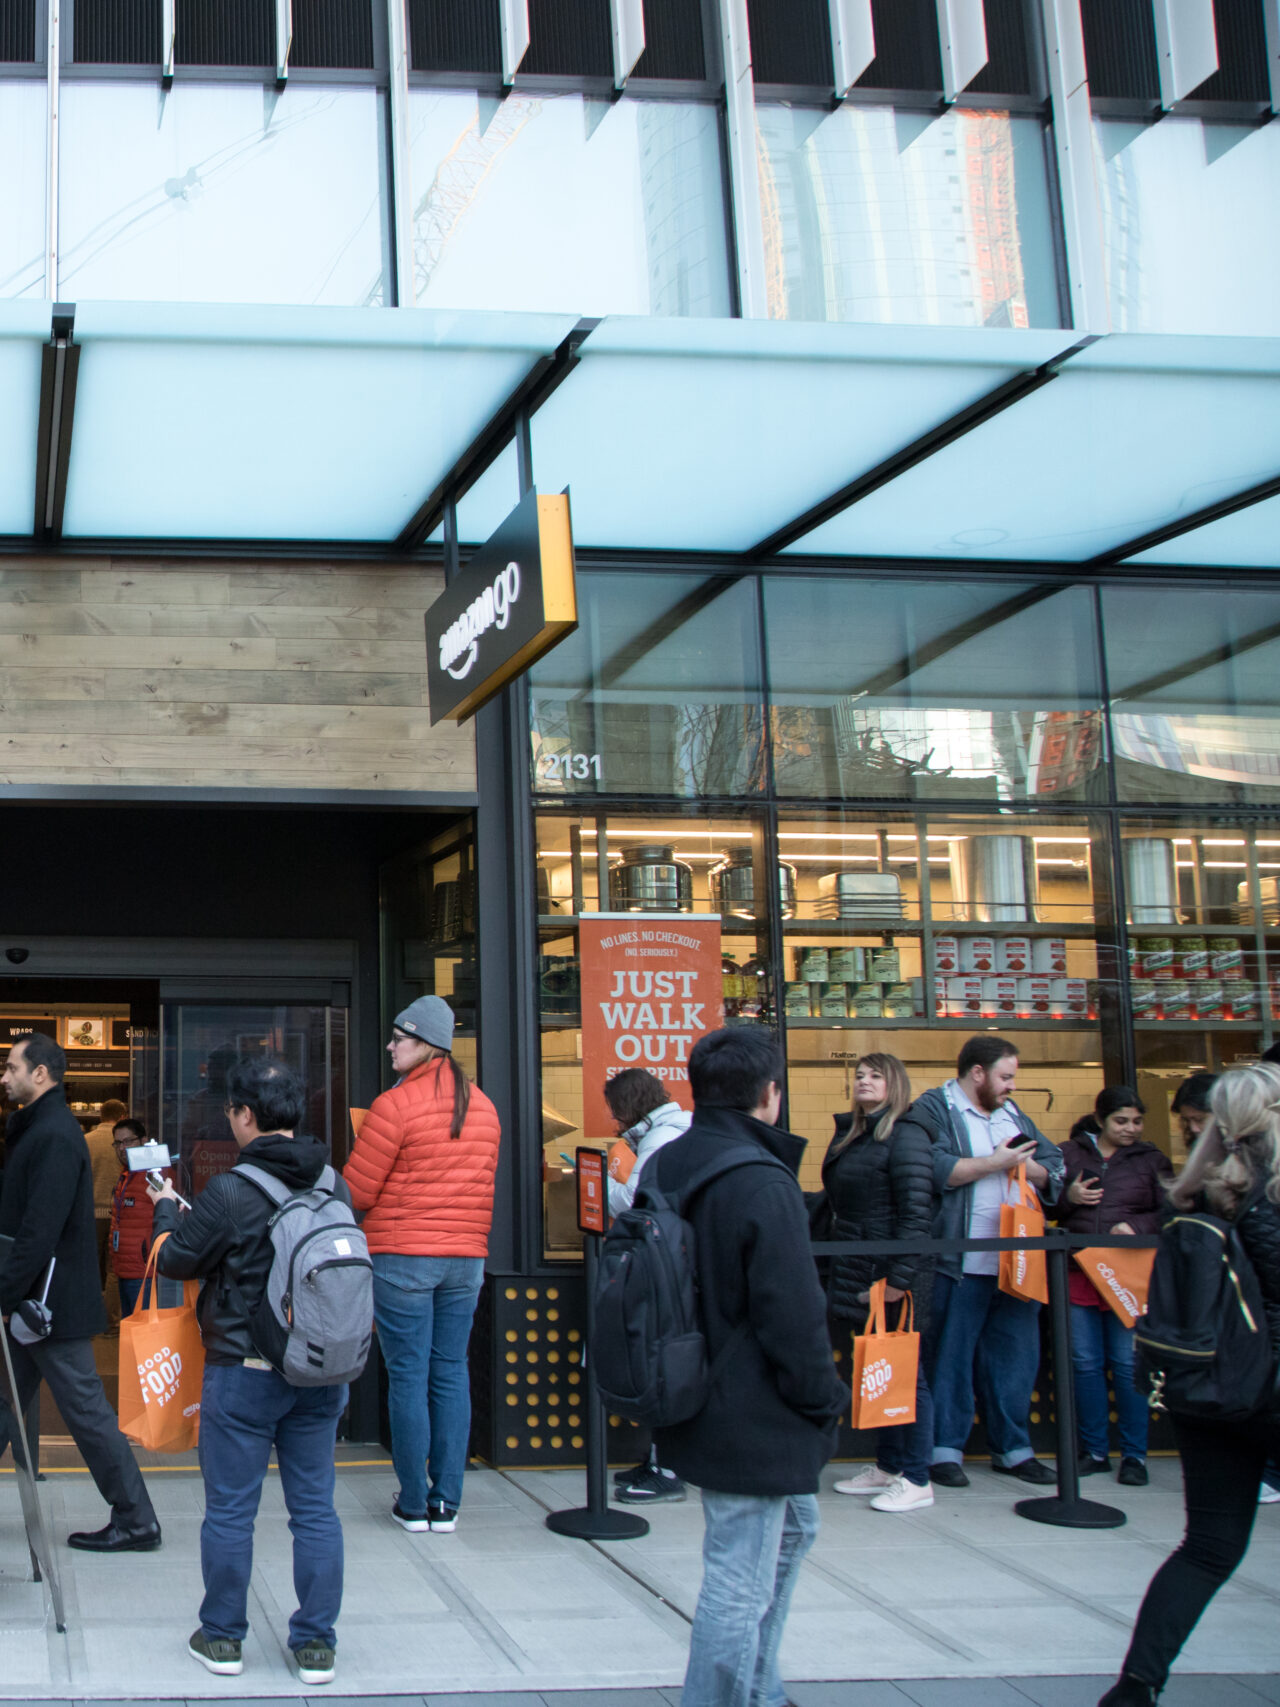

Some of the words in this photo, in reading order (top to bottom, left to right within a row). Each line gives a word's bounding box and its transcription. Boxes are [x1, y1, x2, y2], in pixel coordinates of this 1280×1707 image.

[439, 586, 496, 671] amazon
[493, 562, 520, 630] go
[544, 754, 602, 780] 2131
[600, 936, 614, 950] NO
[614, 931, 640, 946] LINES.
[641, 931, 655, 942] NO
[656, 931, 702, 951] CHECKOUT.
[610, 971, 698, 998] JUST
[600, 1002, 706, 1030] WALK
[615, 1034, 692, 1062] OUT
[199, 1150, 231, 1164] Open
[137, 1346, 171, 1375] GOOD
[157, 1378, 180, 1408] FAST
